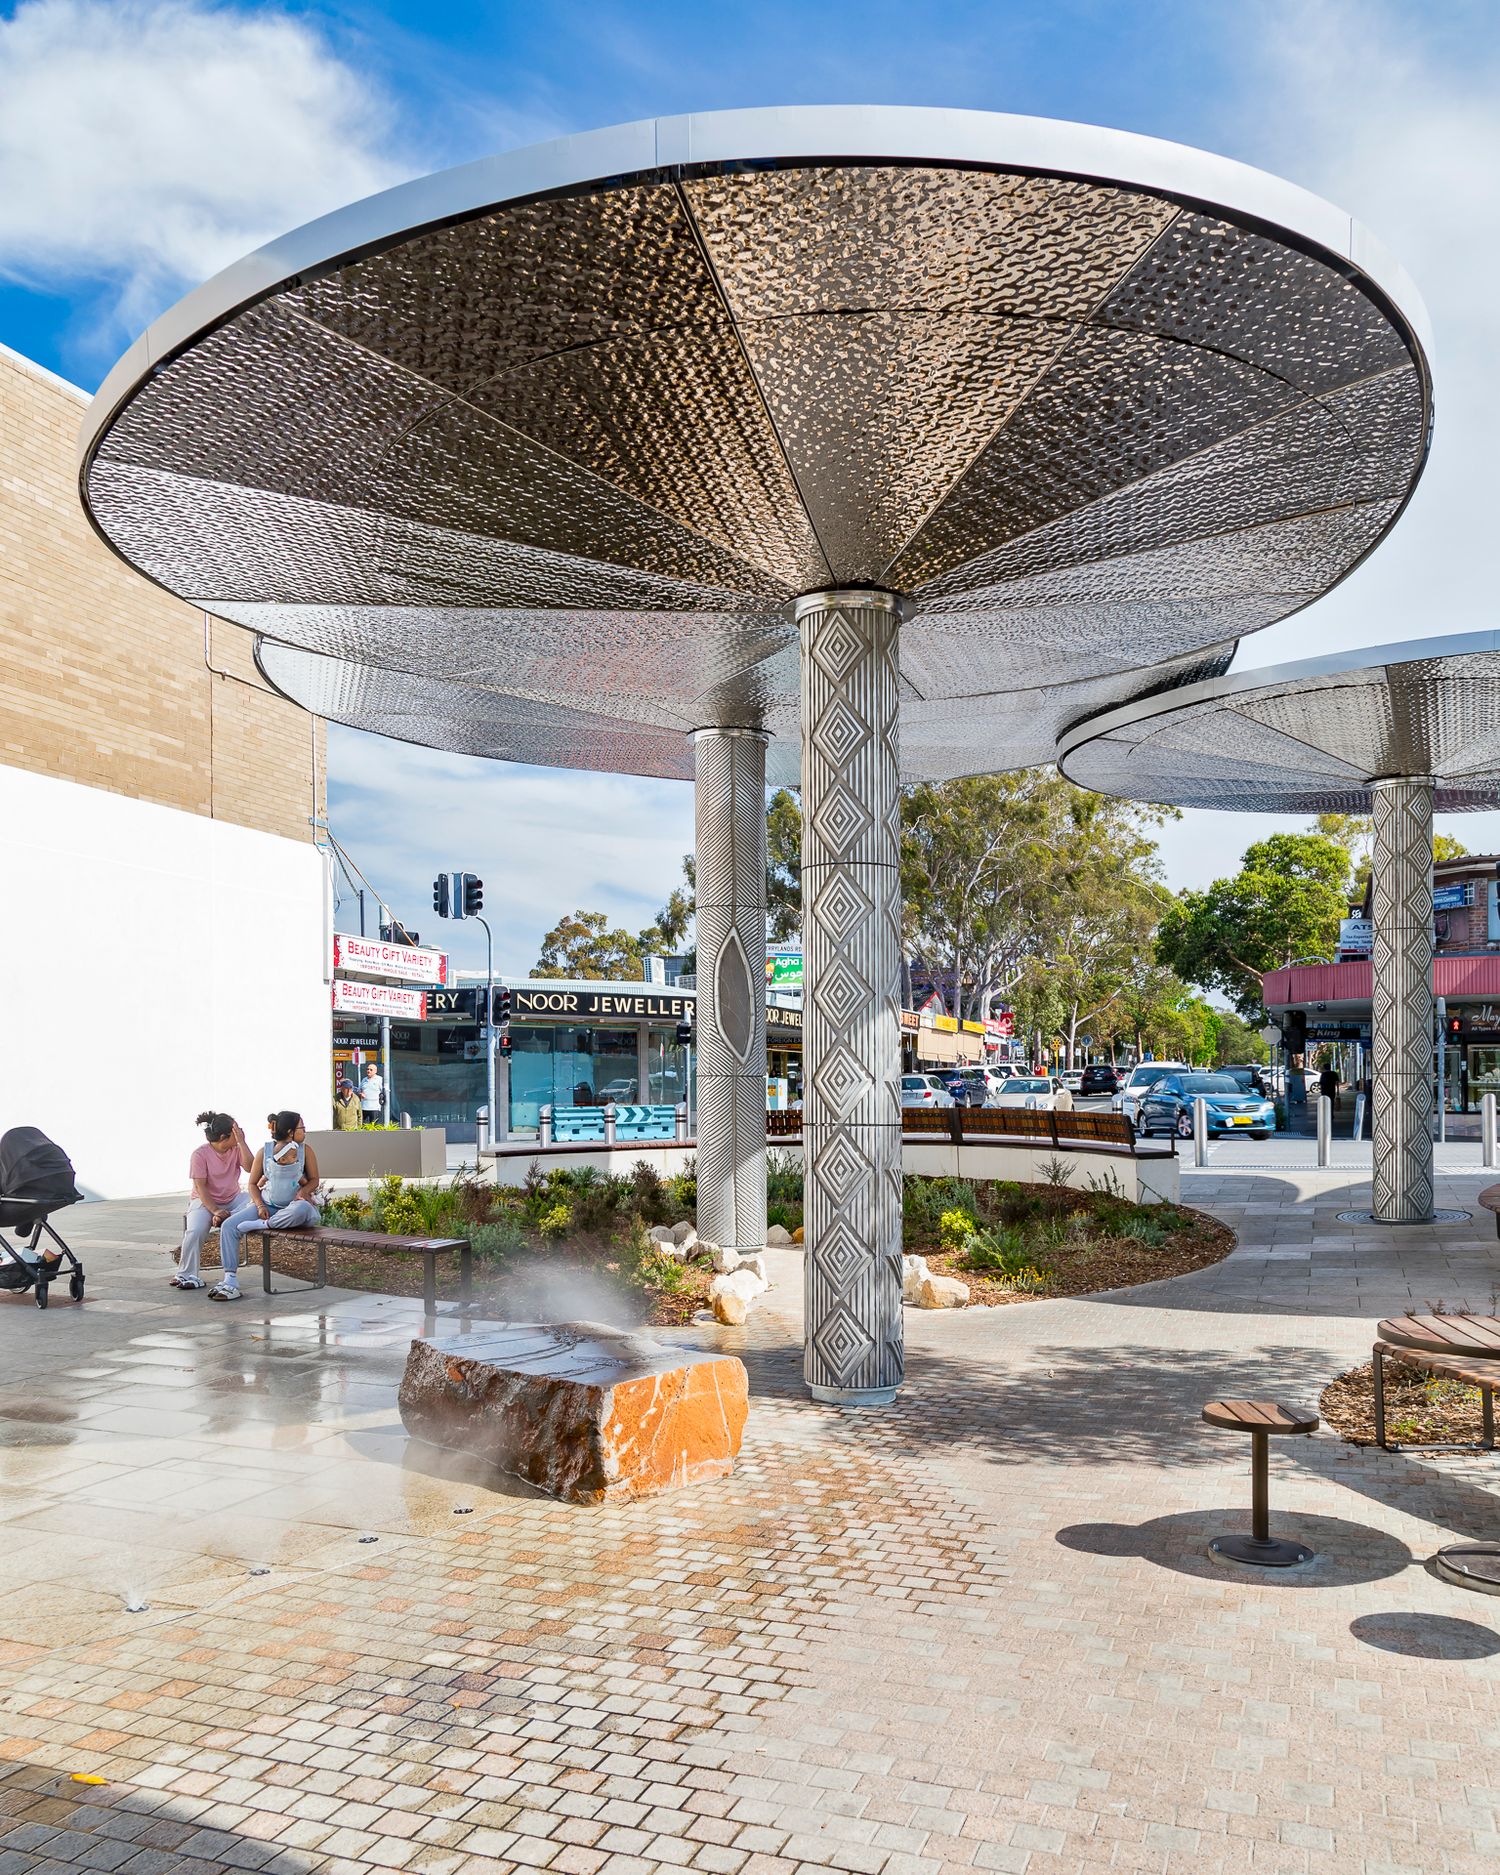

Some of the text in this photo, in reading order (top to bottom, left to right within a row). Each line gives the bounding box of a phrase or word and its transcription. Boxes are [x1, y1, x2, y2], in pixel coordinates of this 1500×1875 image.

[348, 940, 380, 959] BEAUTY
[382, 947, 400, 964] GIFT
[401, 950, 433, 967] VARIETY
[775, 957, 799, 968] Agha
[342, 983, 415, 1004] BEAUTY GIFT VARIETY
[516, 992, 577, 1012] NOOR
[1316, 1029, 1340, 1038] King
[349, 1038, 378, 1046] JEWELLERY
